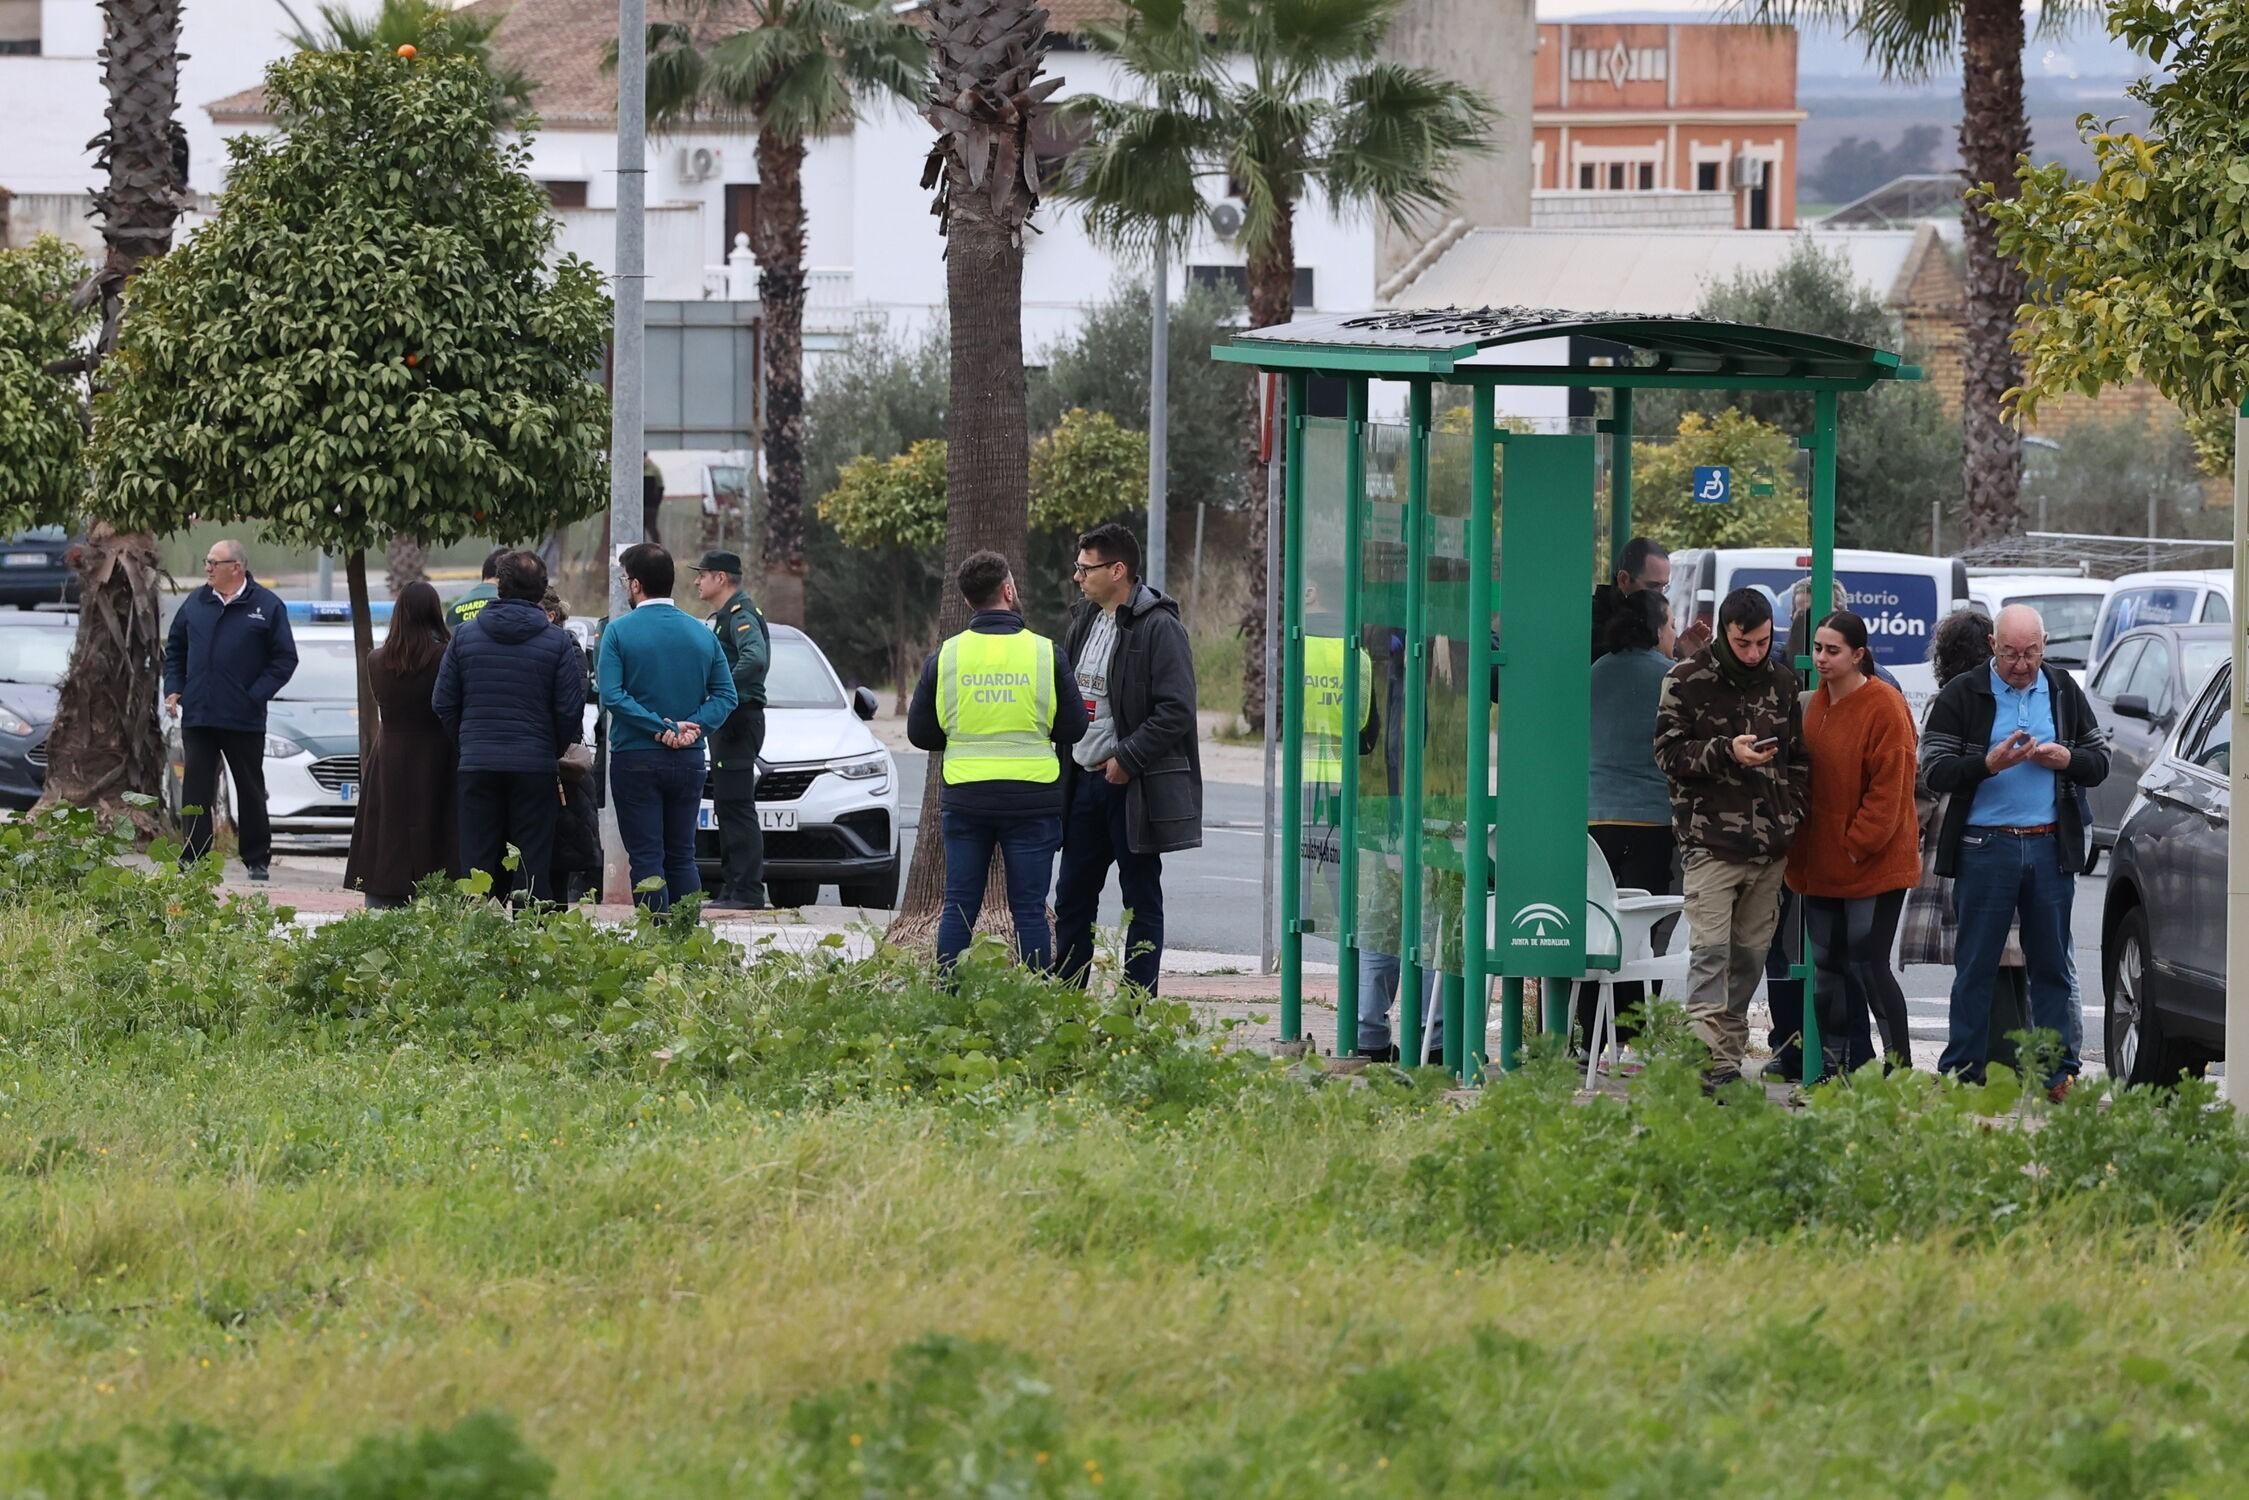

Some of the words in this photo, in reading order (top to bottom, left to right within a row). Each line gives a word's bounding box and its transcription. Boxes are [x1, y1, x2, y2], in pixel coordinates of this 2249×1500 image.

[1846, 590, 1899, 605] atorio
[455, 600, 488, 614] GUARDI
[463, 610, 480, 621] CIV
[1863, 611, 1926, 636] vión
[961, 673, 1030, 687] GUARDIA
[974, 689, 1017, 703] CIVIL
[1904, 691, 1928, 699] RUPO
[764, 812, 795, 828] LYJ
[1511, 938, 1529, 946] JUNTA
[1531, 938, 1538, 946] DE
